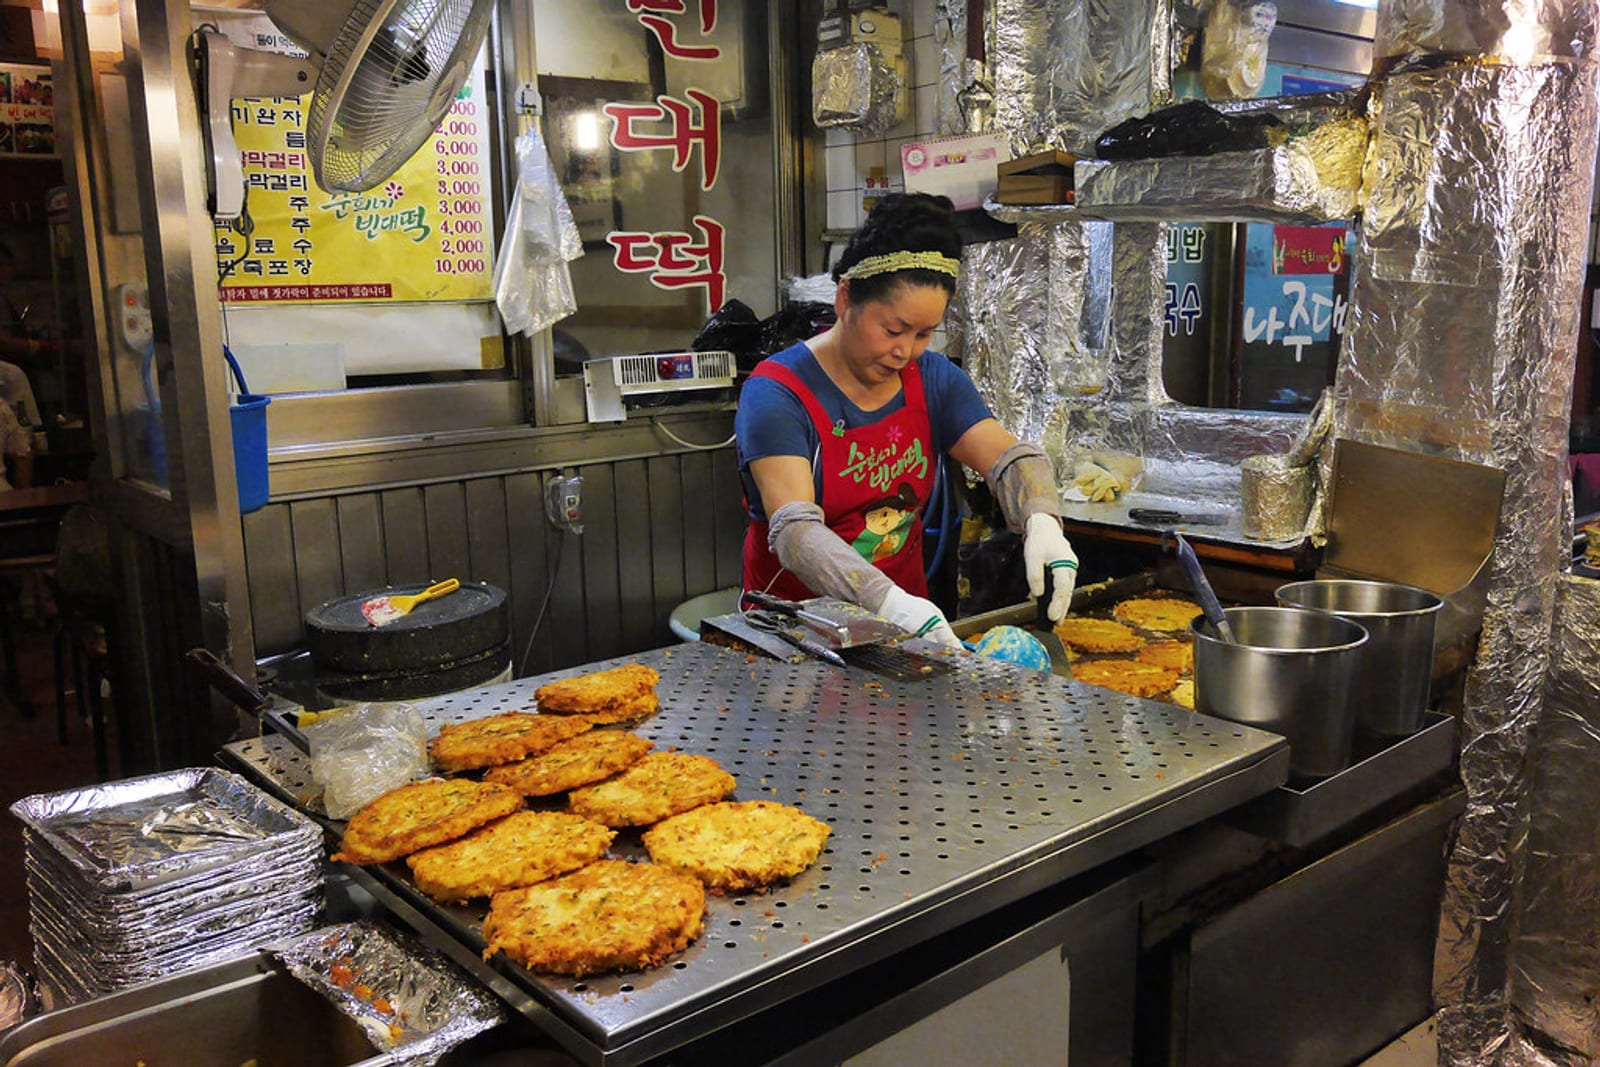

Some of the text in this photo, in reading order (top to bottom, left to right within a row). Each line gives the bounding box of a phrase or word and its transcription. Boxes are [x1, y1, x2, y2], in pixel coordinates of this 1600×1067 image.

[435, 140, 478, 156] 6,000
[437, 159, 479, 176] 3,000
[438, 180, 480, 196] 3,000
[439, 200, 481, 216] 3,000
[355, 205, 431, 243] 빈대떡
[440, 219, 482, 236] 4,000
[441, 239, 483, 256] 2,000
[435, 259, 485, 275] 10,000
